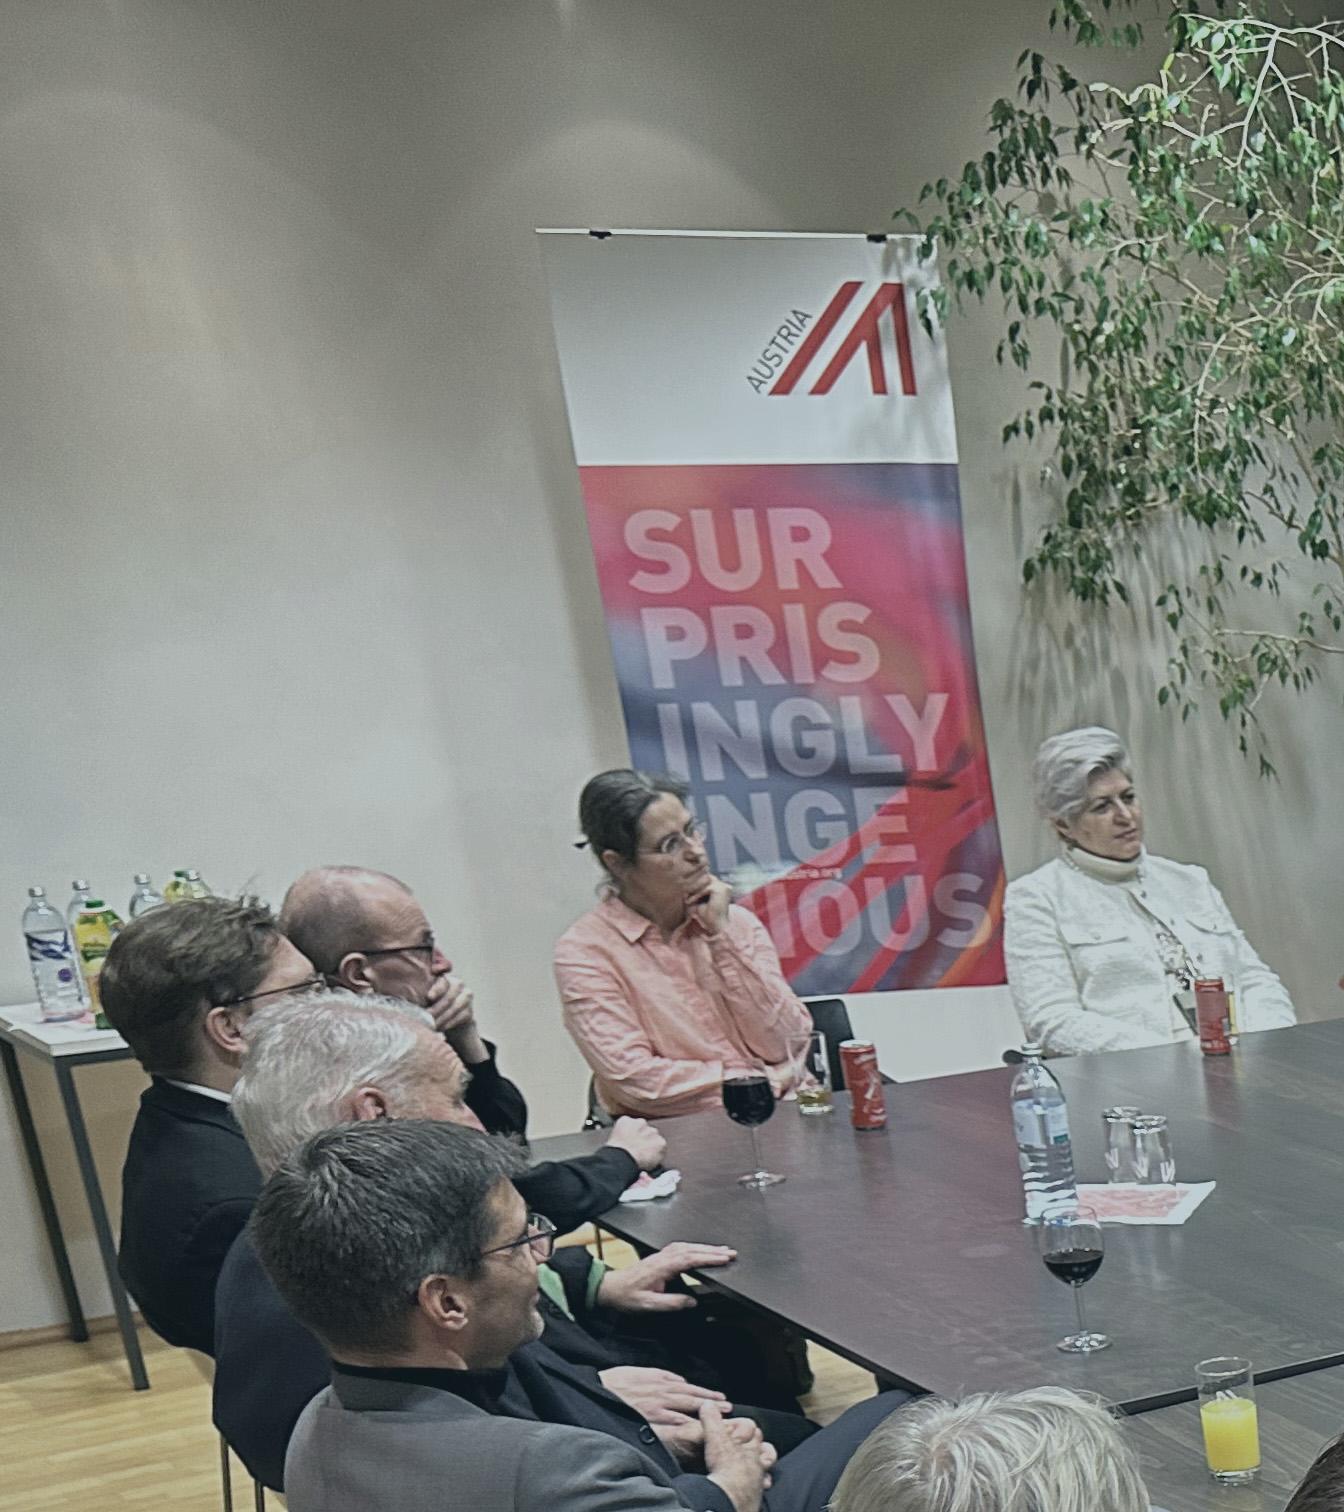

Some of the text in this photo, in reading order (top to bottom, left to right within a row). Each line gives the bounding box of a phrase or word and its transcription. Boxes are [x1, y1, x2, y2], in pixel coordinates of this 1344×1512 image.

[746, 309, 813, 394] AUSTRIA
[624, 507, 844, 594] SUR
[641, 602, 881, 689] PRIS
[657, 693, 949, 782] INGLY
[735, 871, 992, 958] IOUS
